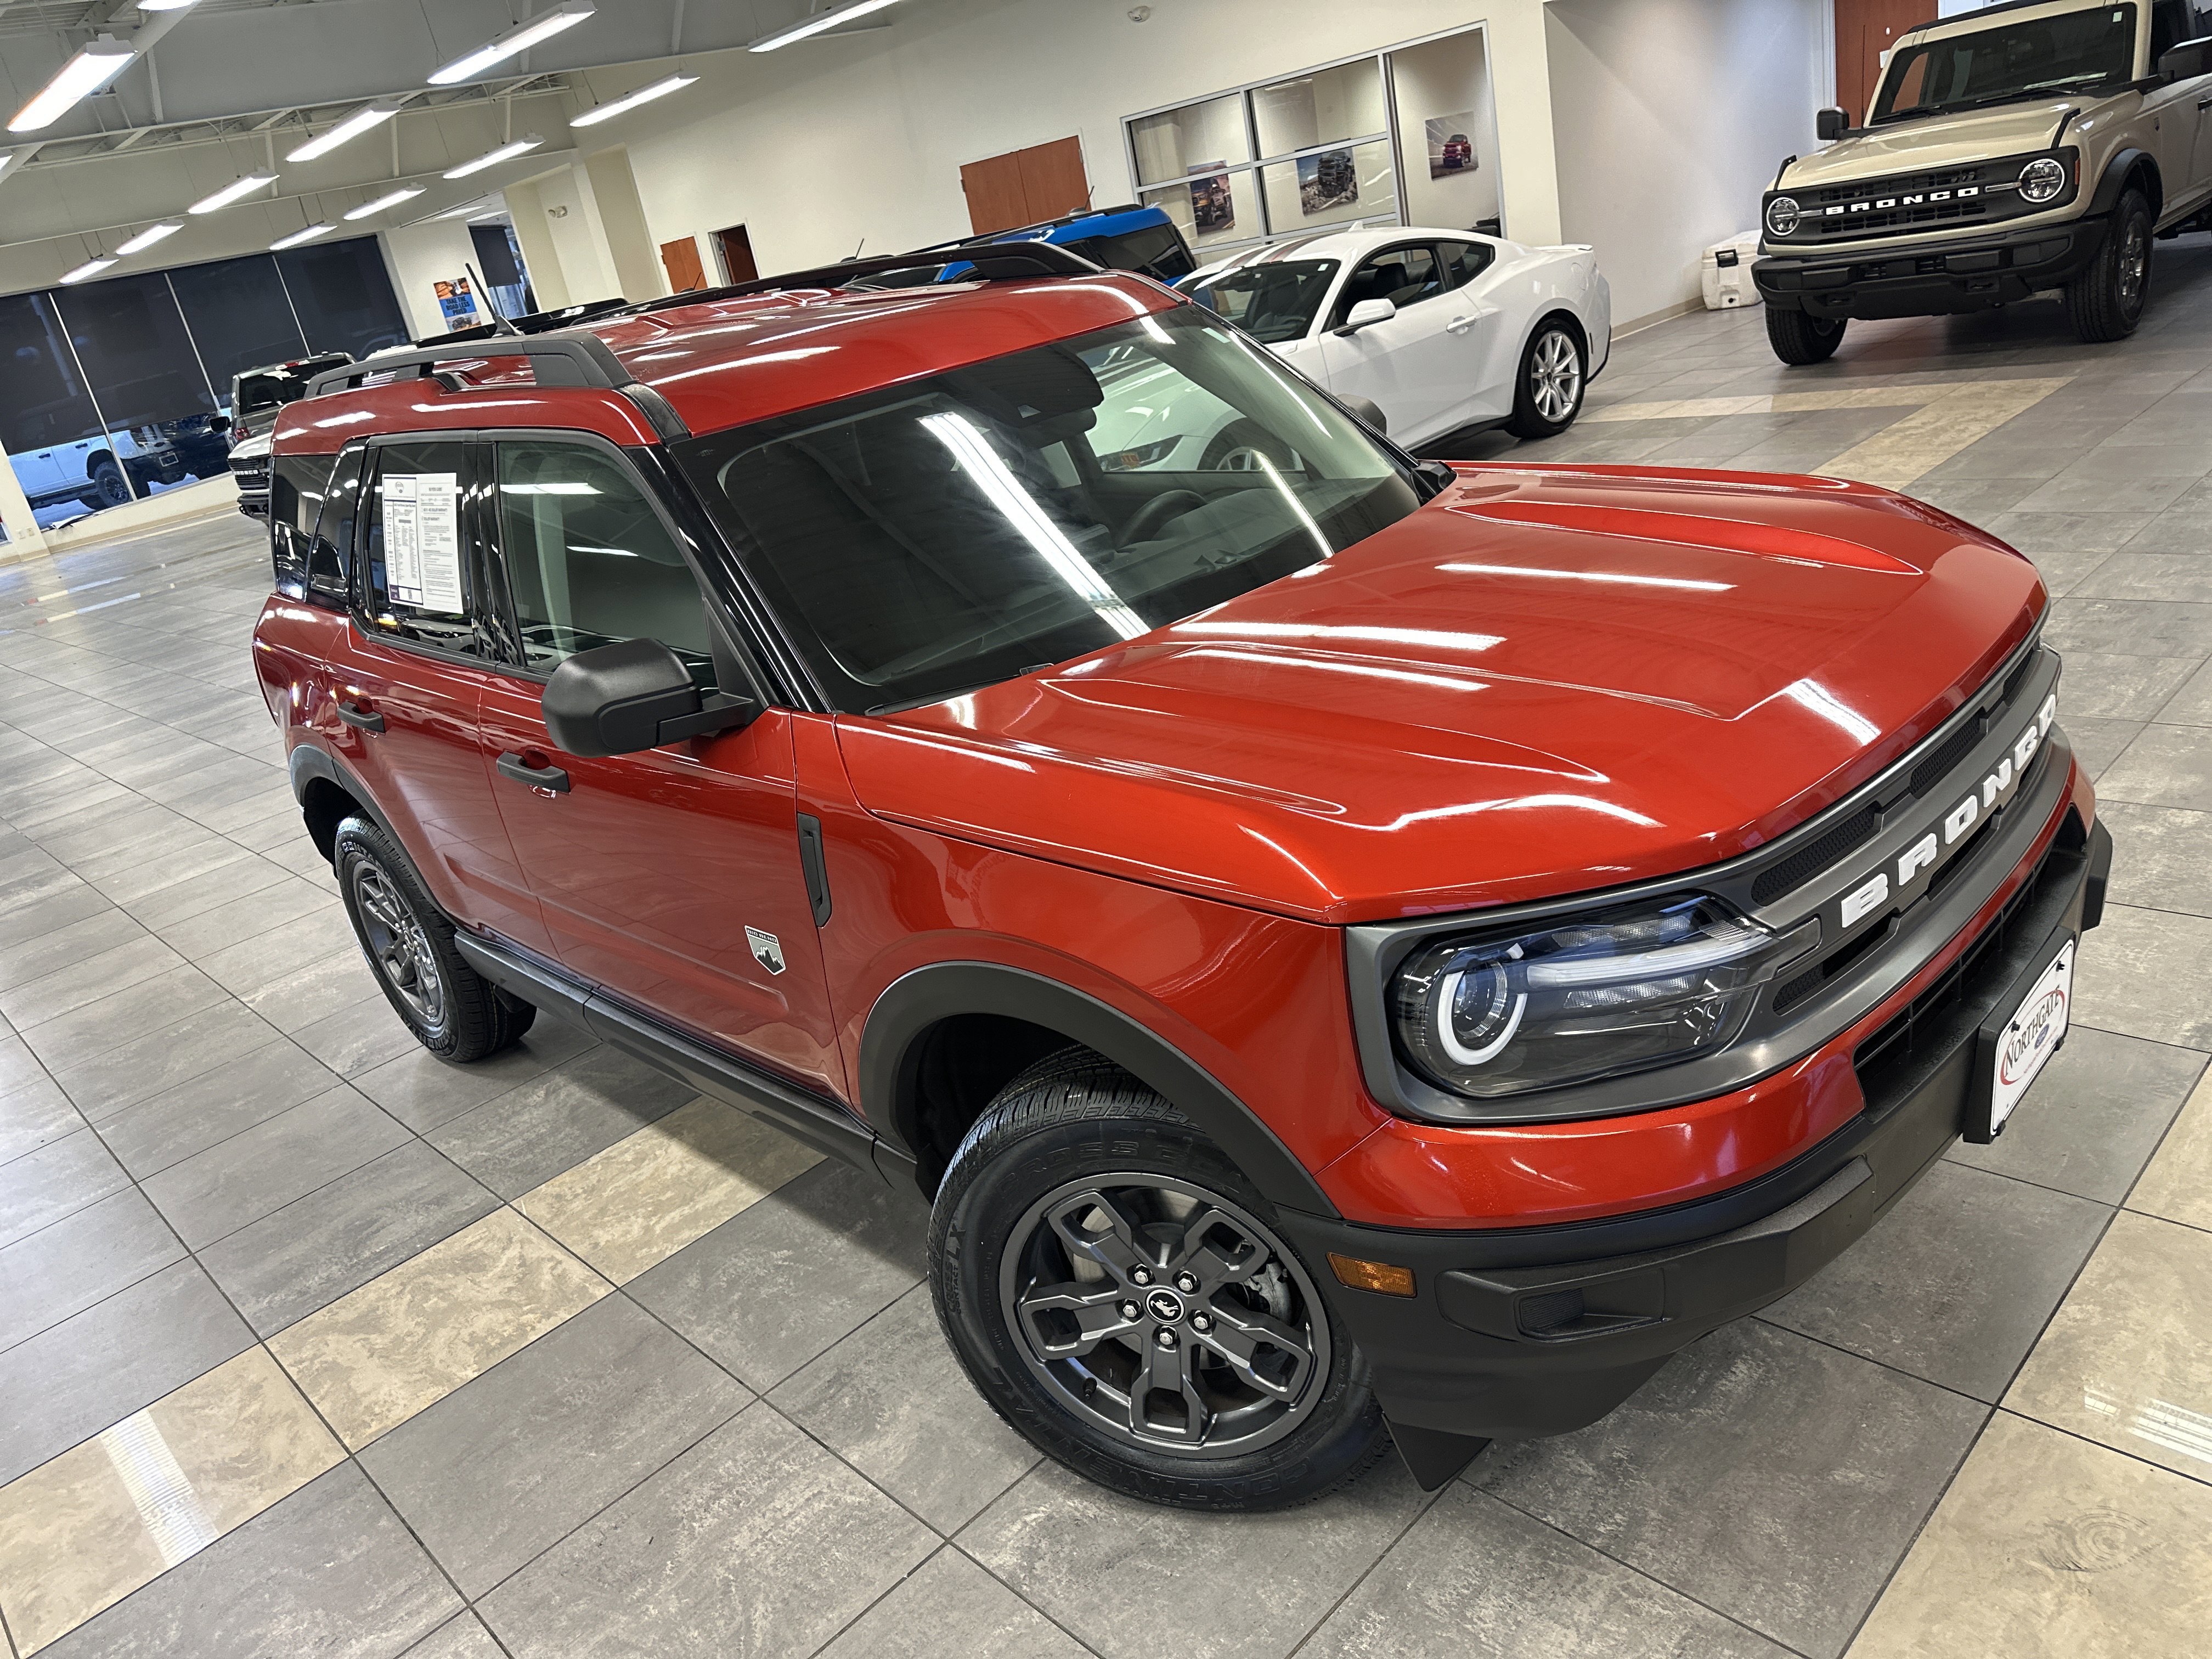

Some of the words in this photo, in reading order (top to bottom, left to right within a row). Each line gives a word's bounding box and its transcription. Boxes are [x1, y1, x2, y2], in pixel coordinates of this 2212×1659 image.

[1826, 187, 1978, 215] BRONCO
[1841, 694, 2056, 928] BRONCO
[2004, 984, 2061, 1079] NORTHGATE
